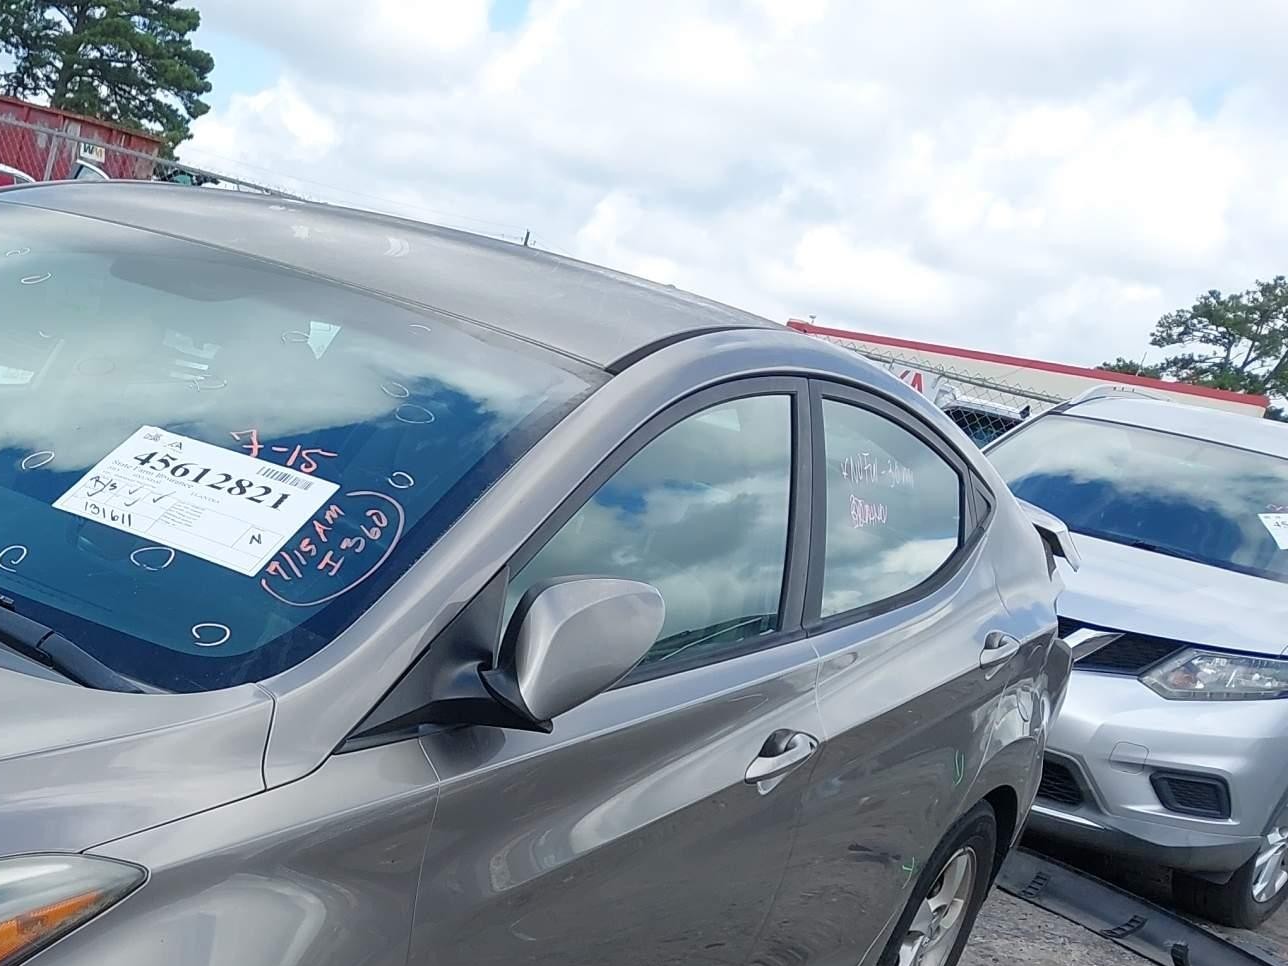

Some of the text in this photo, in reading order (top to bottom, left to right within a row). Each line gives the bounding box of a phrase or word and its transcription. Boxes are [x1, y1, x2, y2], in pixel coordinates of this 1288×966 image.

[230, 429, 338, 473] 7-15
[133, 451, 292, 511] 45612821
[249, 533, 262, 545] N
